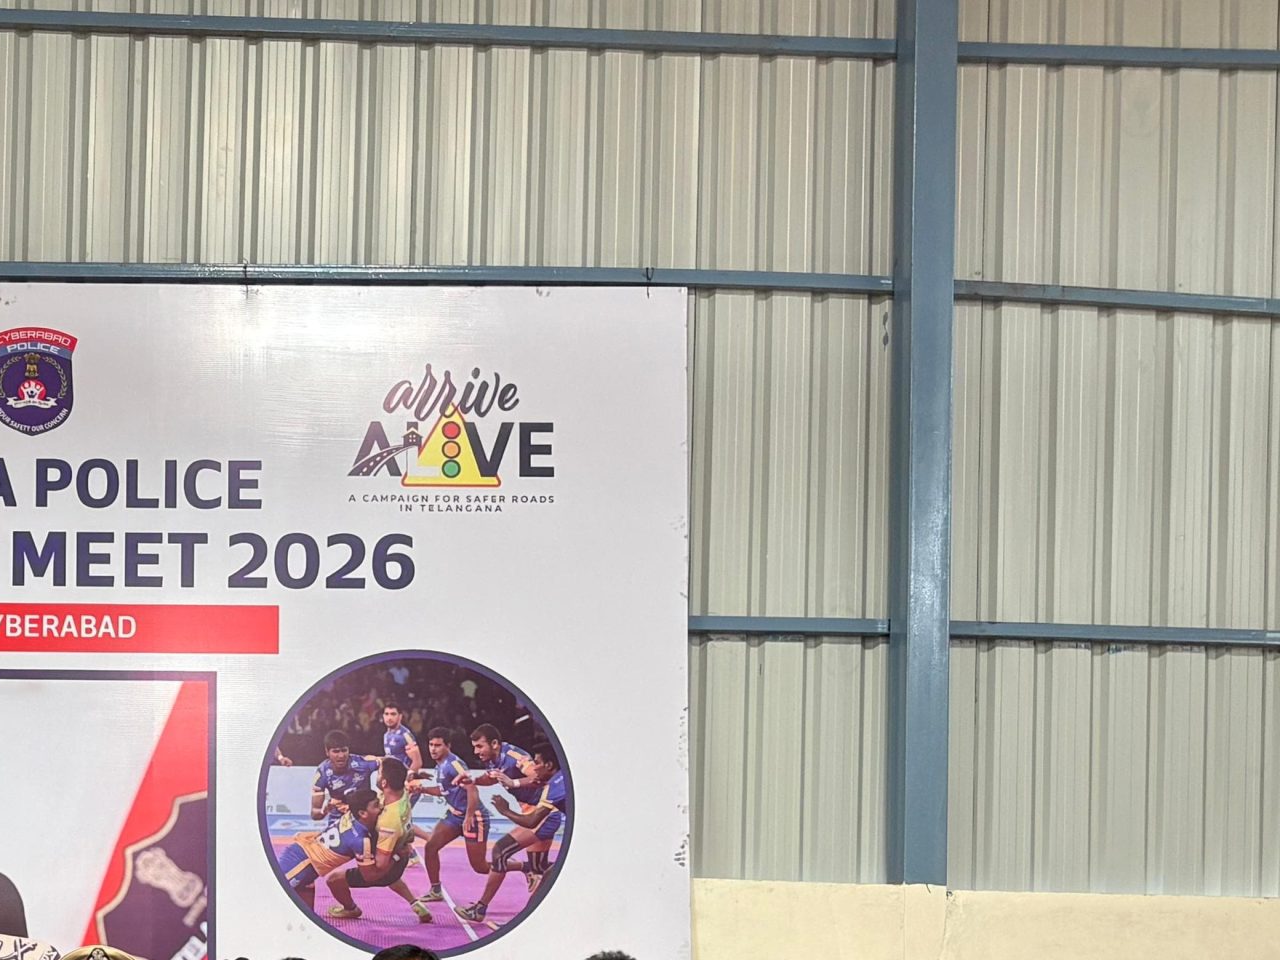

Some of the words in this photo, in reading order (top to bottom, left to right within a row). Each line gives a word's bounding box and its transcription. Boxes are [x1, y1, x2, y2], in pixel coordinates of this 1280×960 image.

[6, 341, 61, 354] POLICE
[382, 363, 520, 421] arrive
[9, 420, 31, 432] SAFETY
[31, 423, 45, 432] OUR
[44, 407, 69, 429] CONCERN
[36, 458, 263, 510] POLICE
[348, 494, 357, 503] A
[362, 494, 429, 503] CAMPAIGN
[435, 495, 460, 503] FOR
[465, 495, 506, 503] SAFER
[511, 495, 555, 504] ROADS
[399, 504, 413, 512] IN
[420, 504, 503, 513] TELANGANA
[12, 531, 209, 588] MEET
[227, 532, 416, 590] 2026
